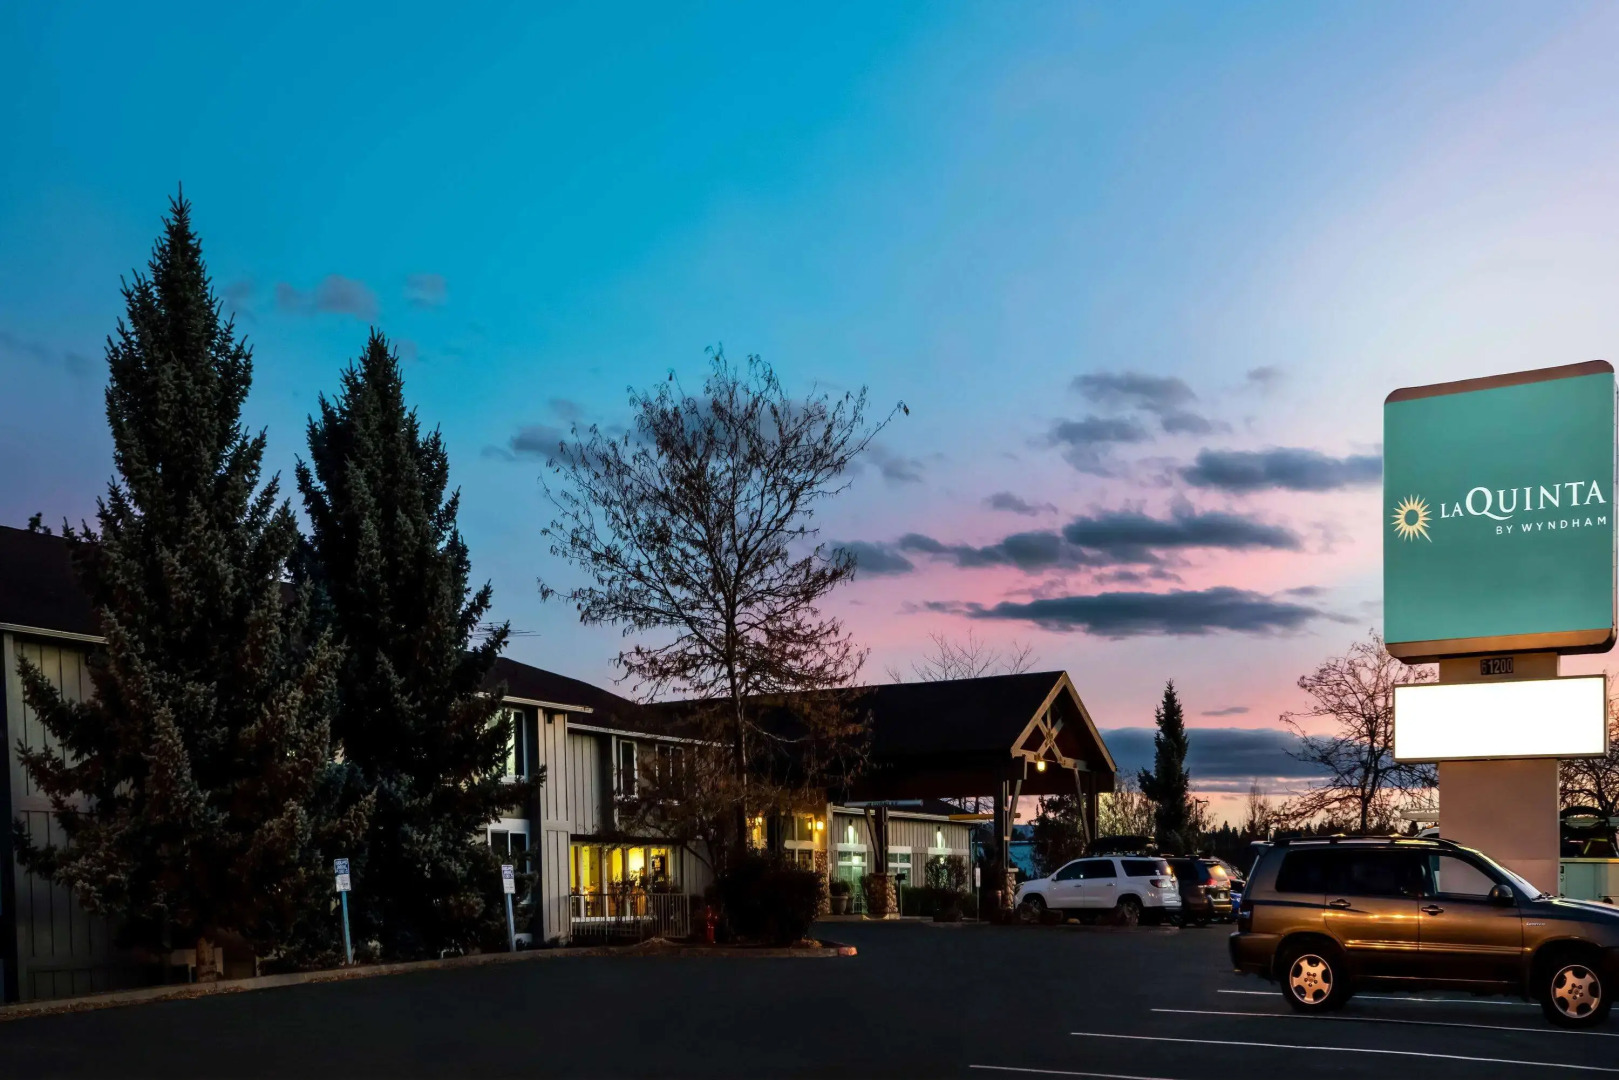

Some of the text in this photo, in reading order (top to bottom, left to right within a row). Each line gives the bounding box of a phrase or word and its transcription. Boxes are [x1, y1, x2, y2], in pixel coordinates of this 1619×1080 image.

[1441, 480, 1607, 521] LA QUINTA
[1496, 516, 1607, 535] BY WYNDHAM
